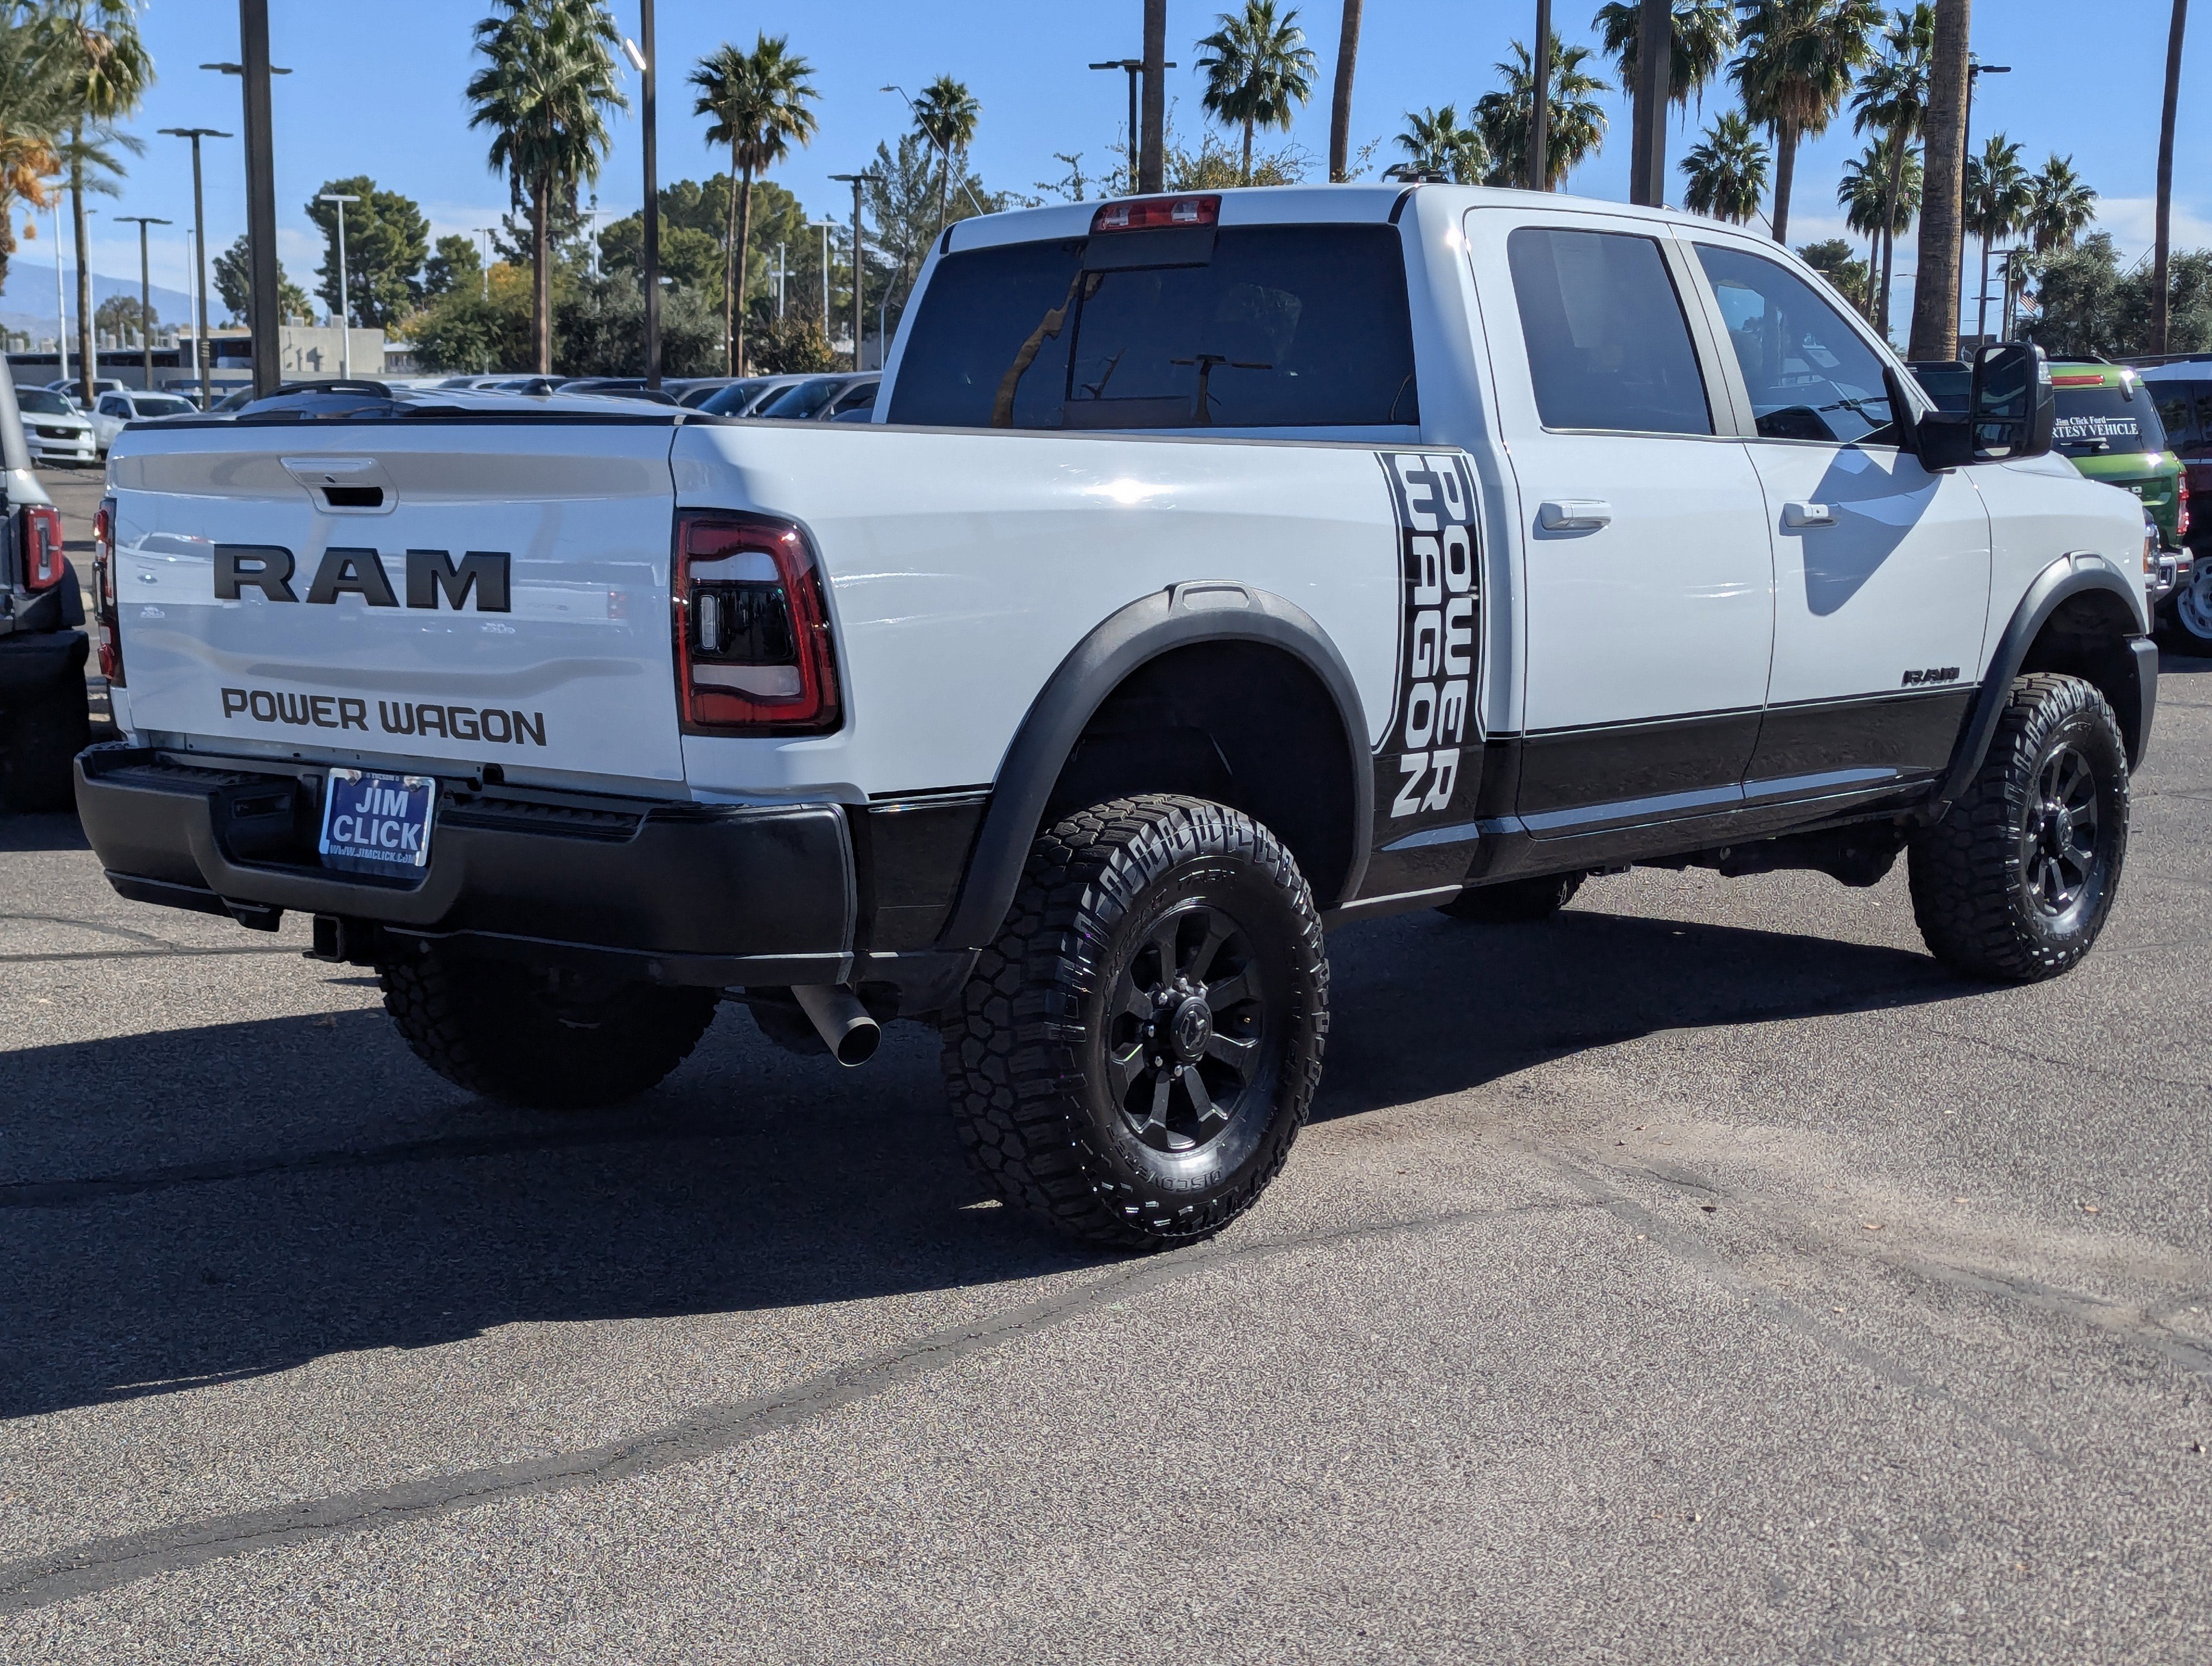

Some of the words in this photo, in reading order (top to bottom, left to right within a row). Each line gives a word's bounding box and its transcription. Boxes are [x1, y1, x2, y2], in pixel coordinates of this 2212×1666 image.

[2088, 423, 2139, 436] VEHICLE
[214, 543, 511, 613] RAM
[1391, 454, 1441, 818] WAGON
[1421, 455, 1472, 811] POWER
[1902, 667, 1960, 685] RAM
[220, 687, 369, 731] POWER
[378, 700, 547, 746] WAGON
[355, 787, 409, 818] JIM
[333, 815, 422, 851] CLICK
